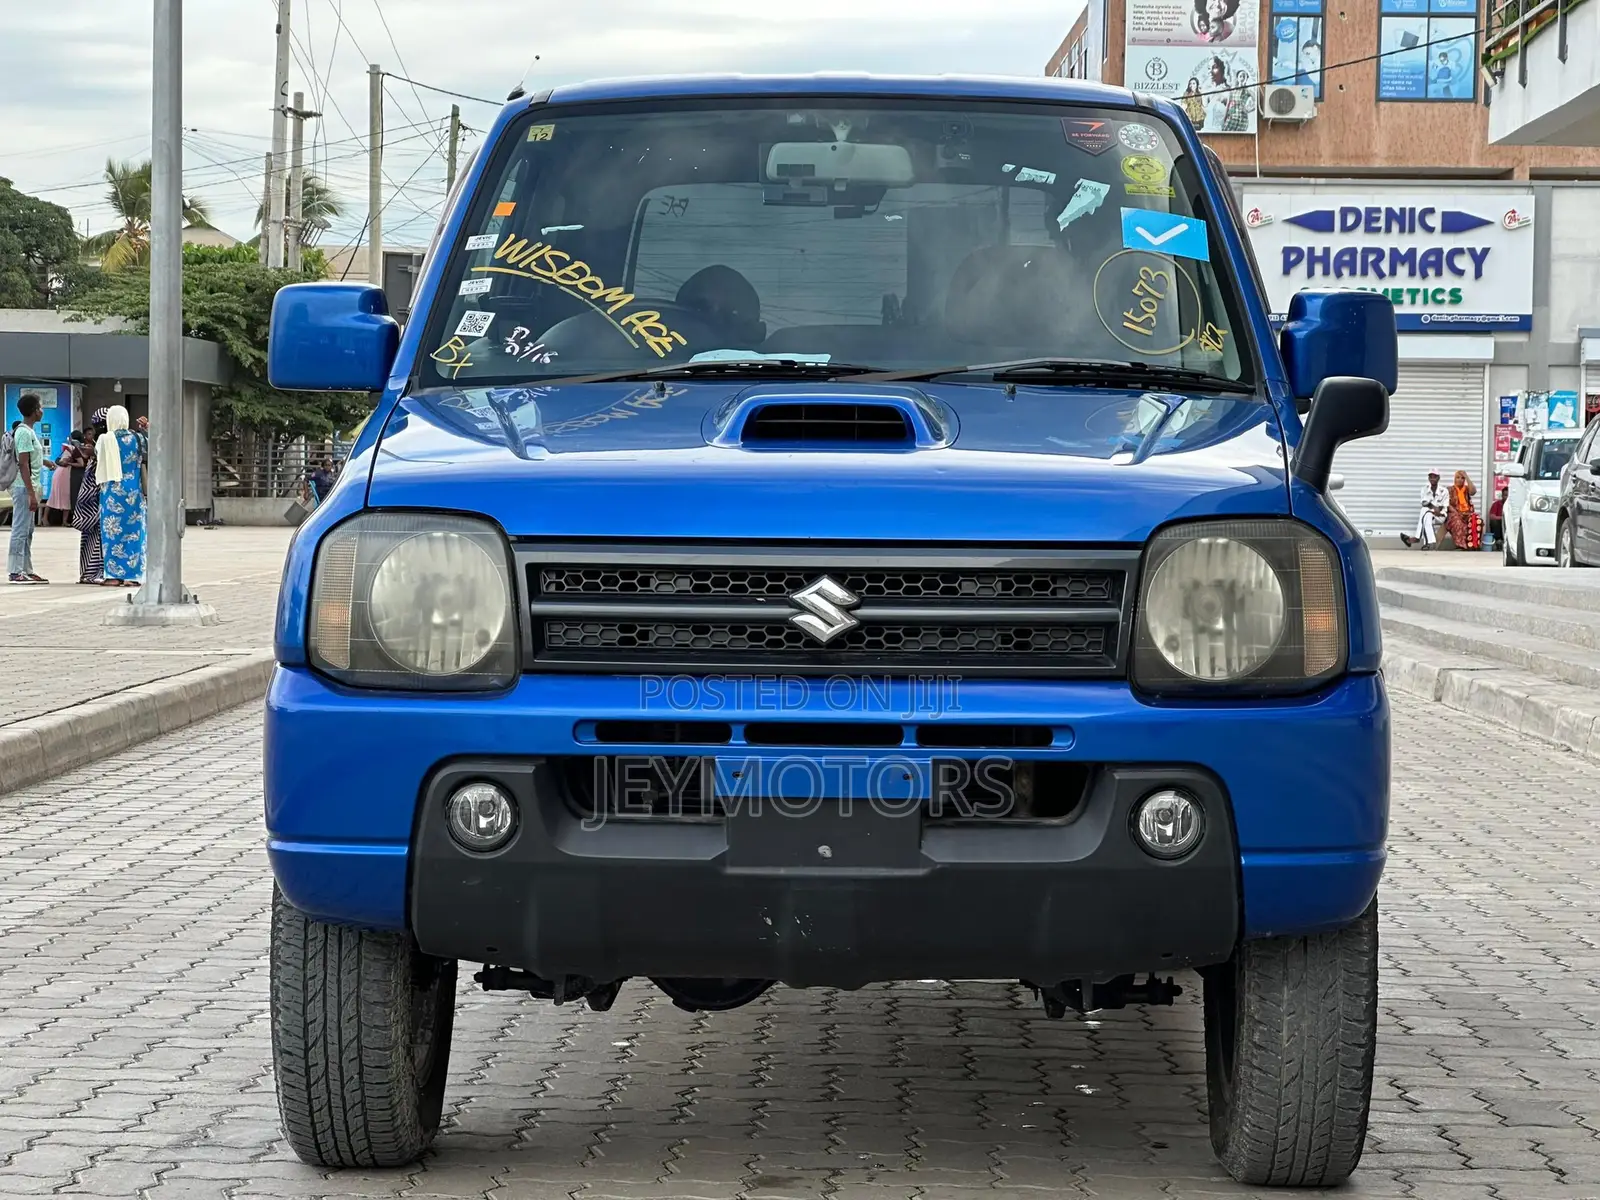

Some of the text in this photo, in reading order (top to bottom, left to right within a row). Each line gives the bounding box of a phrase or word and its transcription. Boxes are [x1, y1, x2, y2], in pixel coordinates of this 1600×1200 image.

[1133, 82, 1180, 90] BIZZLEST
[532, 133, 548, 141] 12
[1339, 206, 1436, 234] DENIC
[494, 233, 635, 314] WISDOM
[1281, 246, 1492, 280] PHARMACY
